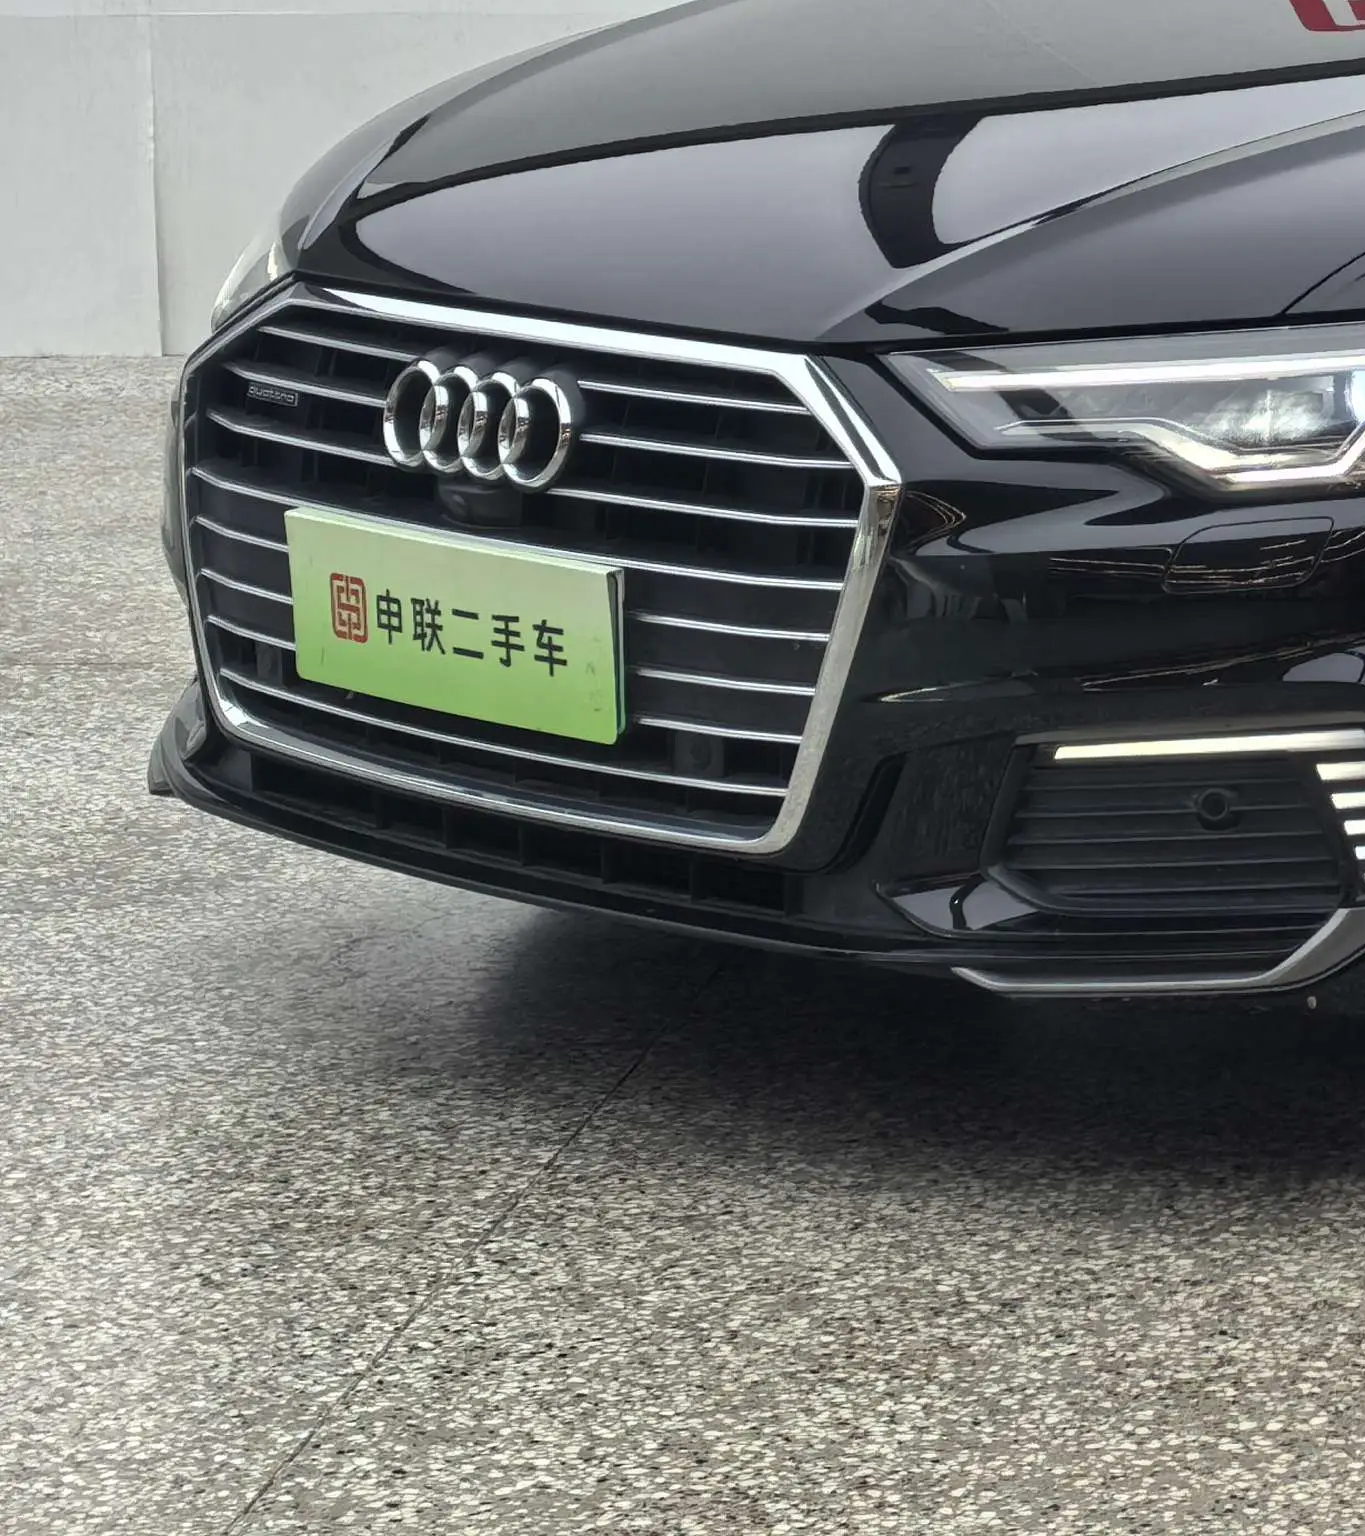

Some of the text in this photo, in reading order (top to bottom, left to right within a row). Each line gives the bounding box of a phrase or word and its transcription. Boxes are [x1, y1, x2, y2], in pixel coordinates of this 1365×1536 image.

[376, 589, 568, 677] 申联二手车
